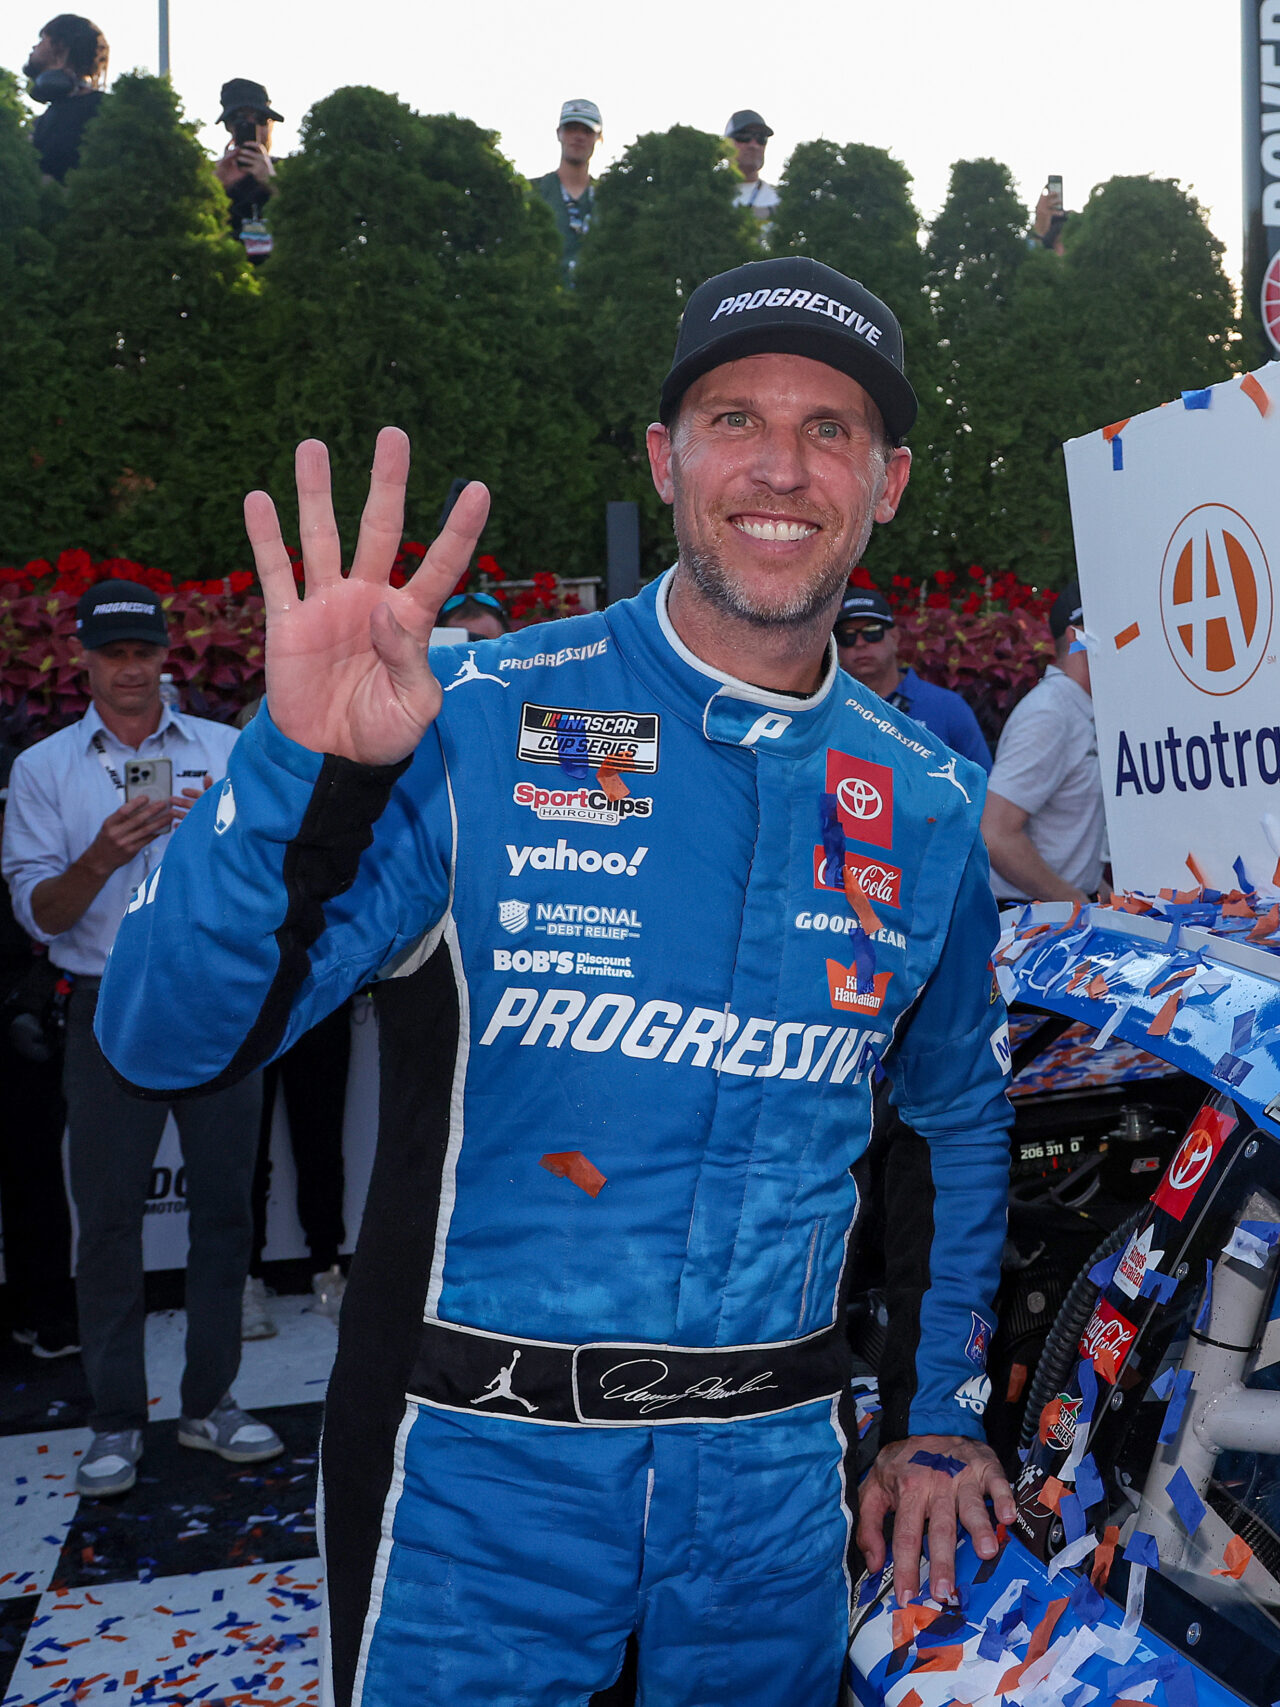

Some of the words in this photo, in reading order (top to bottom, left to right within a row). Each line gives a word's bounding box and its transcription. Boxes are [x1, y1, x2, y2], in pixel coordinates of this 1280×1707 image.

[709, 286, 883, 347] PROGRESSIVE
[498, 637, 609, 671] PROGRESSIVE
[567, 713, 639, 735] NASCAR
[738, 711, 793, 746] P
[538, 735, 574, 753] CUP
[575, 736, 639, 758] SERIES
[541, 808, 615, 822] HAIRCUTS
[505, 838, 649, 877] yahoo!
[536, 902, 643, 928] NATIONAL
[546, 922, 583, 937] DEBT
[584, 926, 630, 941] RELIEF
[493, 949, 575, 975] BOB'S
[576, 952, 632, 967] Discount
[834, 986, 882, 1009] Hawaiian
[478, 986, 888, 1085] PROGRESSIVE
[1020, 1146, 1044, 1160] 206
[1046, 1143, 1064, 1157] 311
